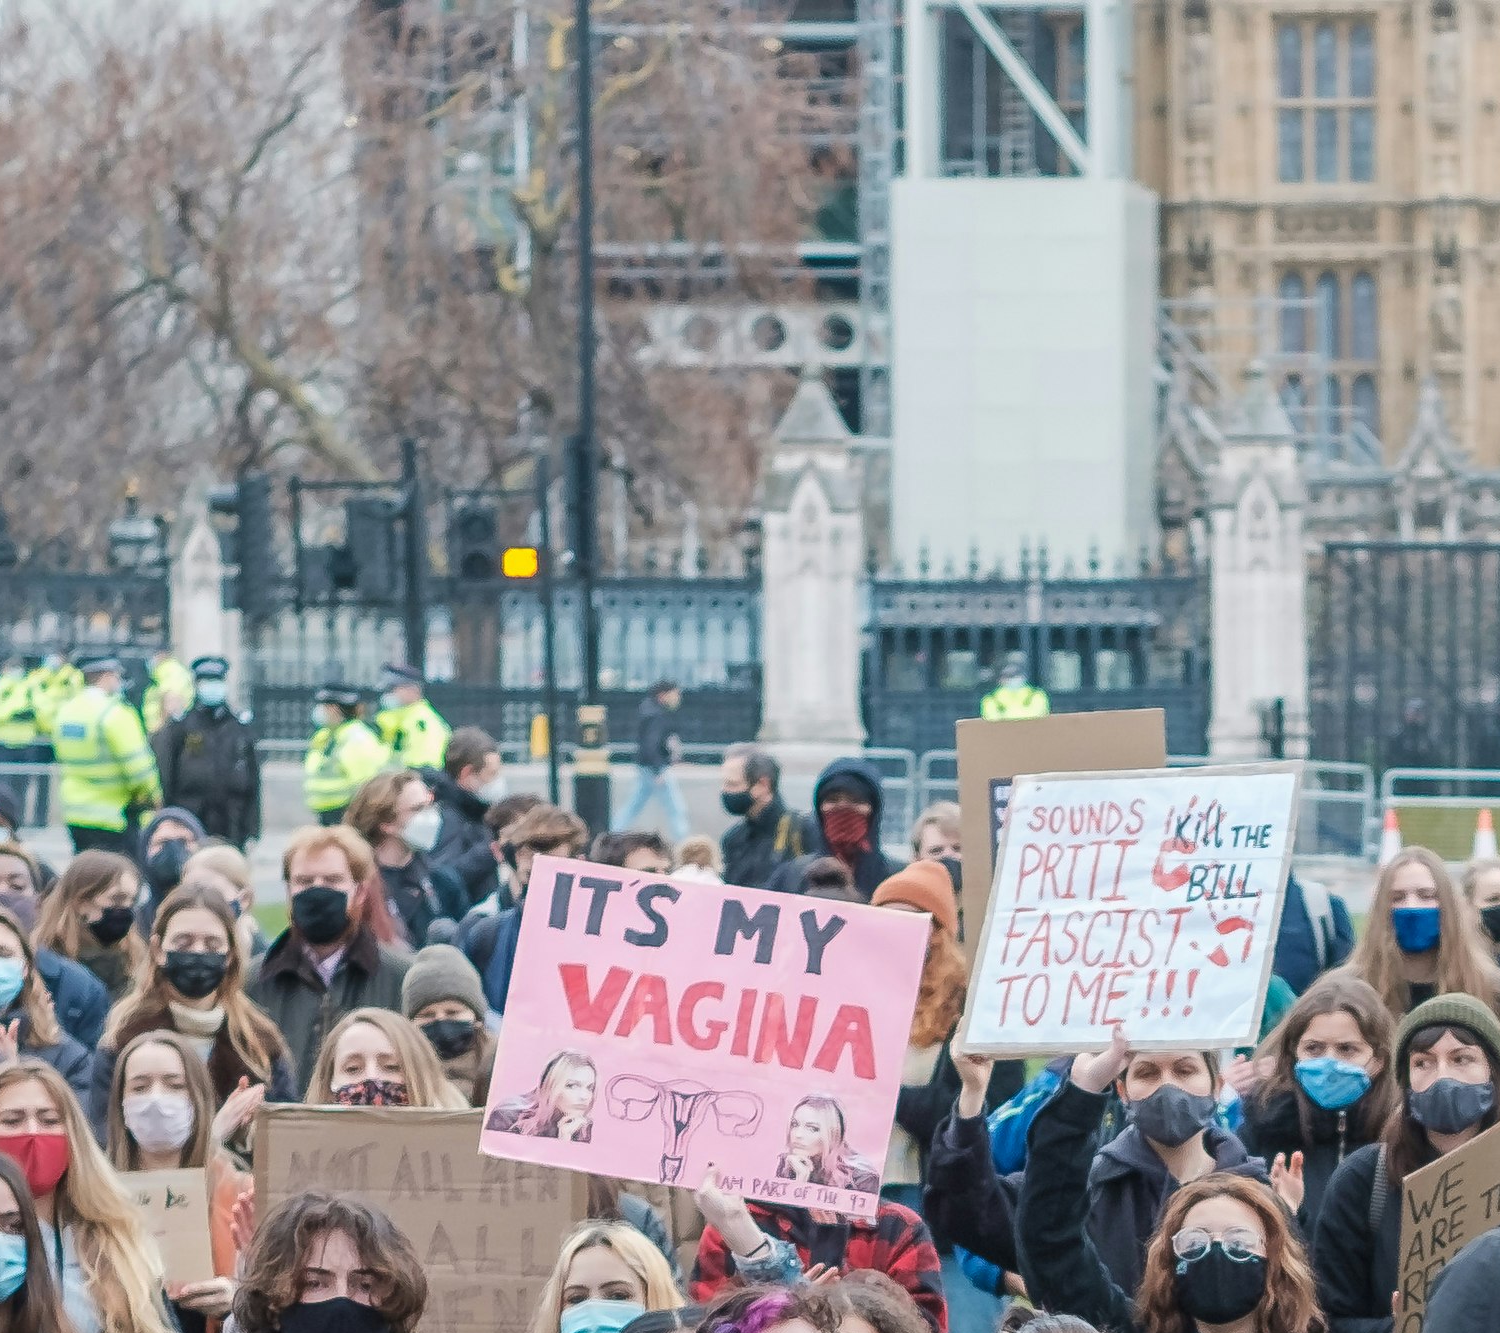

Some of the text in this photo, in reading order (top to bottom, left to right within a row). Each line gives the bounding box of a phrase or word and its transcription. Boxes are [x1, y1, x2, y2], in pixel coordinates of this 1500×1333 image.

[1027, 798, 1146, 837] SOUNDS
[1230, 823, 1272, 849] THE
[1015, 838, 1139, 903] PRITI
[1185, 861, 1262, 903] BILL
[713, 898, 847, 976] MY
[1000, 906, 1193, 970] FASCIST
[557, 962, 877, 1081] VAGINA
[996, 972, 1051, 1028] TO
[751, 1176, 789, 1199] PART
[1407, 1160, 1466, 1225] WE
[1404, 1203, 1468, 1271] ARE
